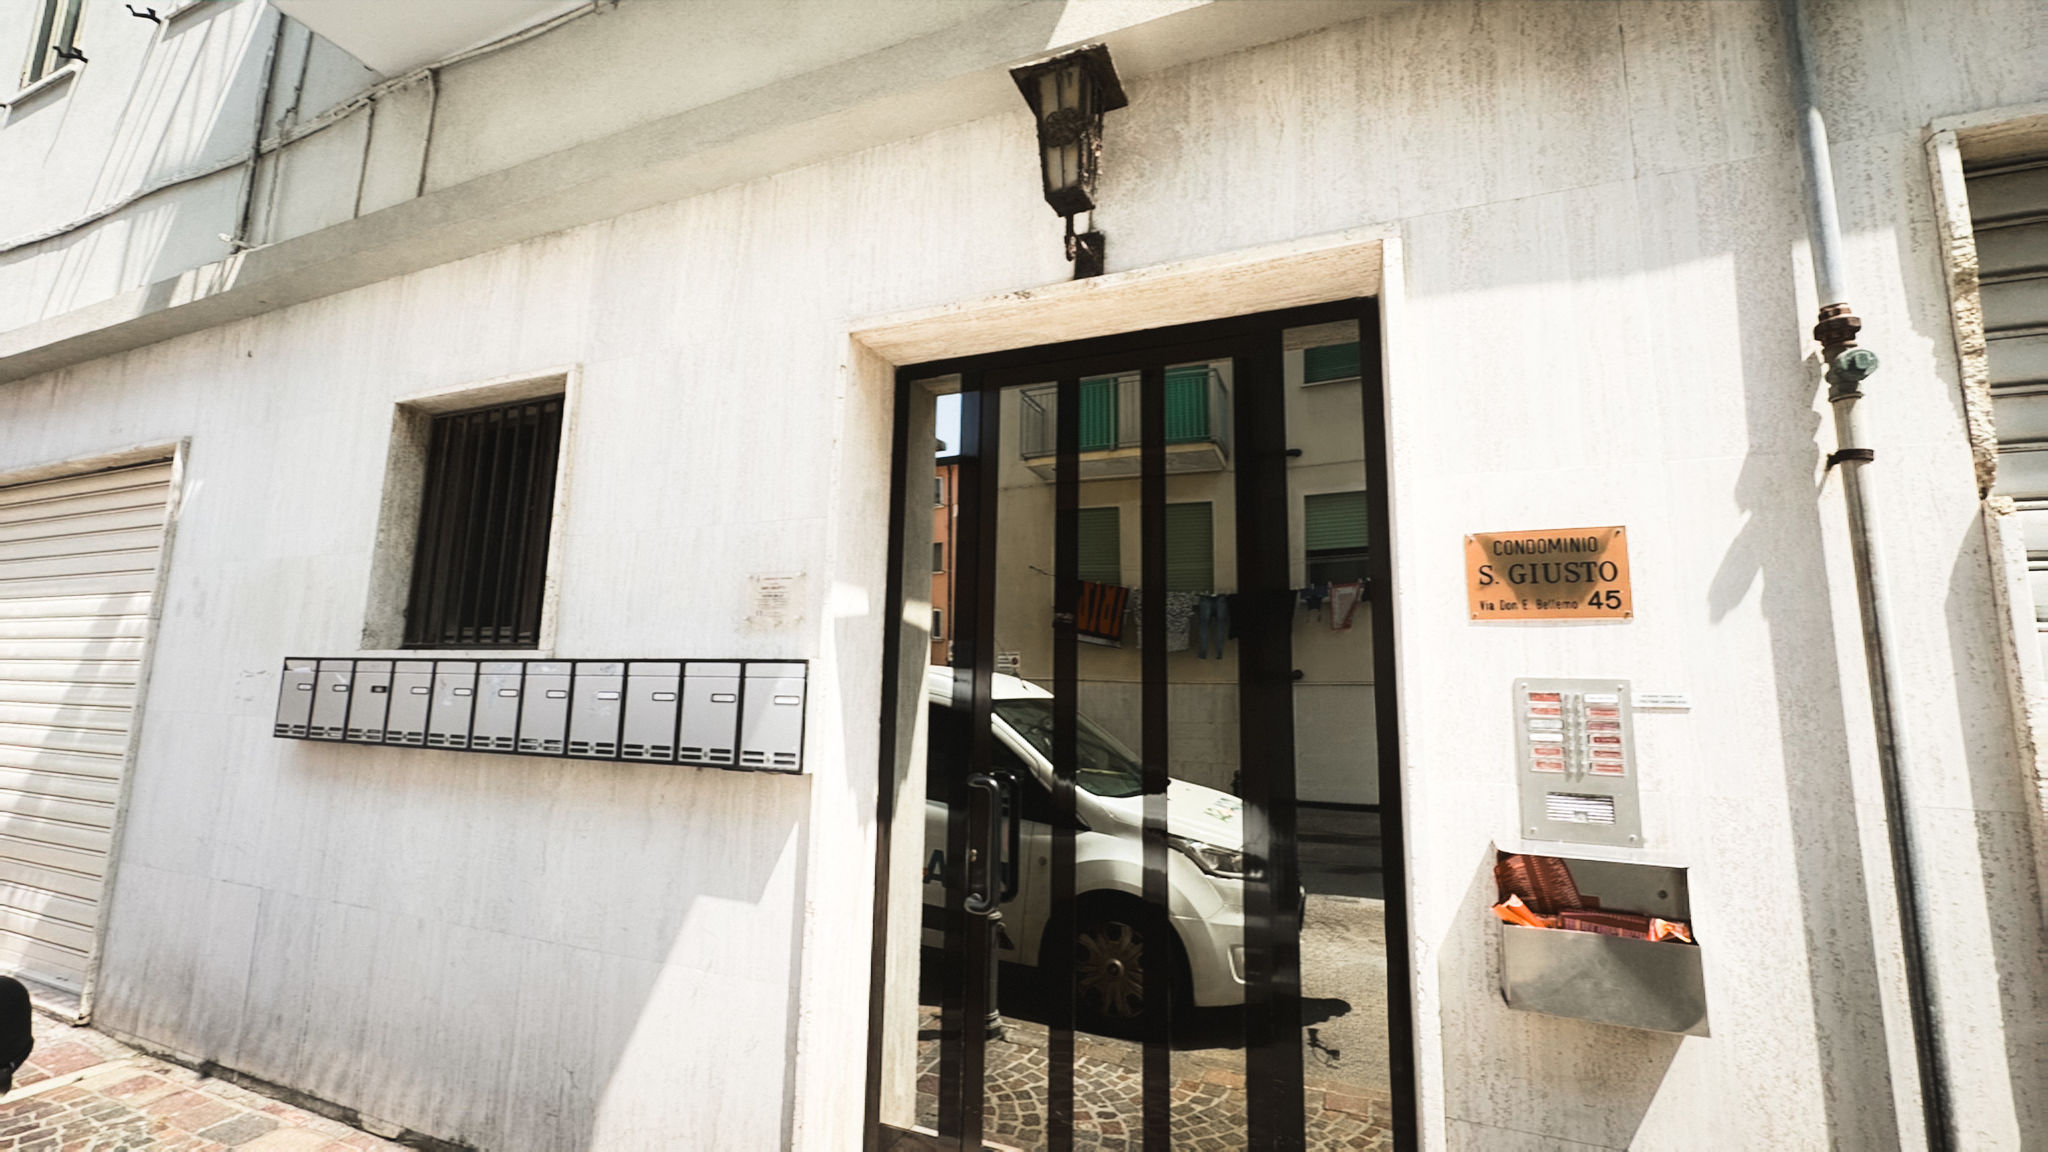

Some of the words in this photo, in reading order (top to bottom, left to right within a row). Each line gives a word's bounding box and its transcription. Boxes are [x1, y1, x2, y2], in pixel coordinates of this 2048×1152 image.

[1493, 536, 1598, 556] CONDOMINIO
[1478, 564, 1500, 586] S.
[1508, 560, 1618, 584] GIUSTO
[1480, 600, 1495, 611] Via
[1588, 590, 1622, 610] 45
